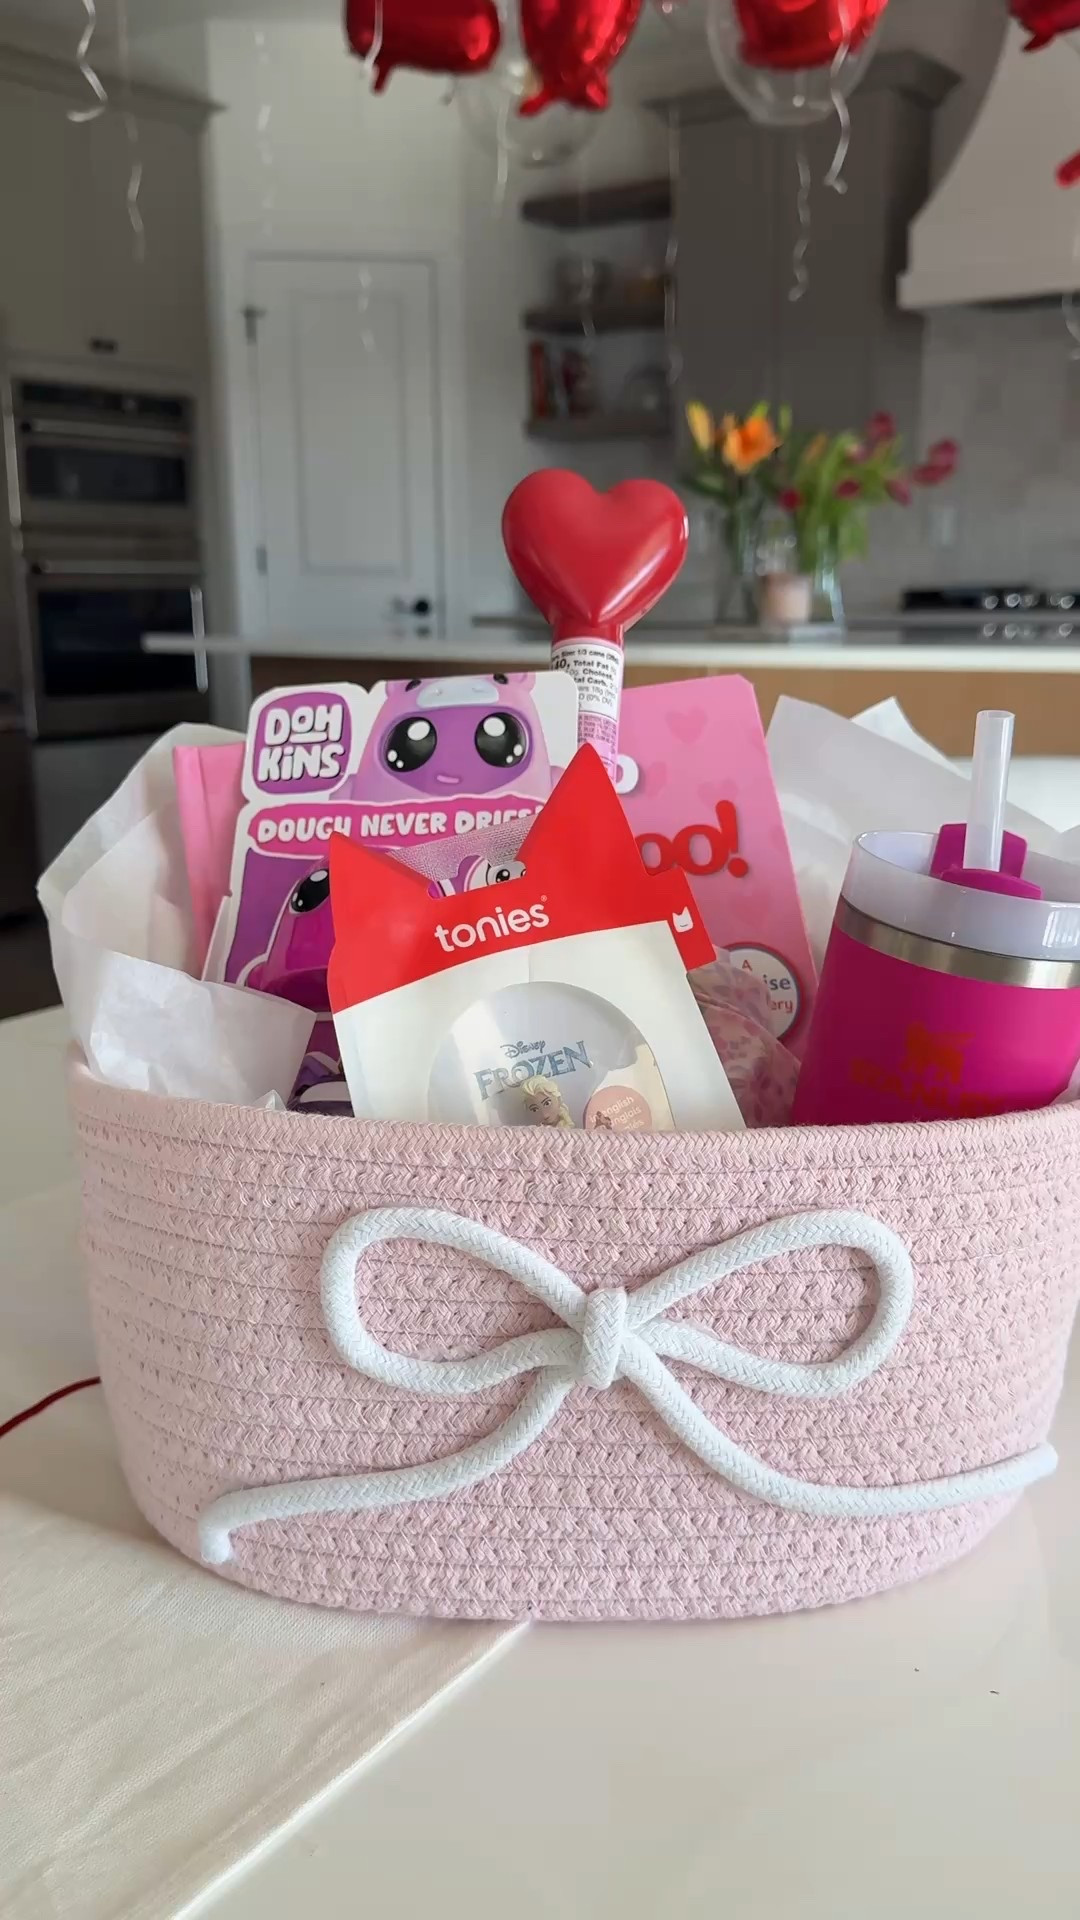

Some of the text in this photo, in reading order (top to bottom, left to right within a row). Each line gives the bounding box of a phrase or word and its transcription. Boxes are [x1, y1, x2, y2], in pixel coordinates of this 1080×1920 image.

[596, 662, 609, 670] Fat
[264, 704, 344, 747] DOH
[257, 816, 352, 843] DOUGH
[361, 811, 447, 837] NEVER
[635, 800, 749, 878] oo!
[434, 903, 550, 952] tonies
[741, 960, 753, 972] A
[473, 1040, 593, 1100] FROZEN
